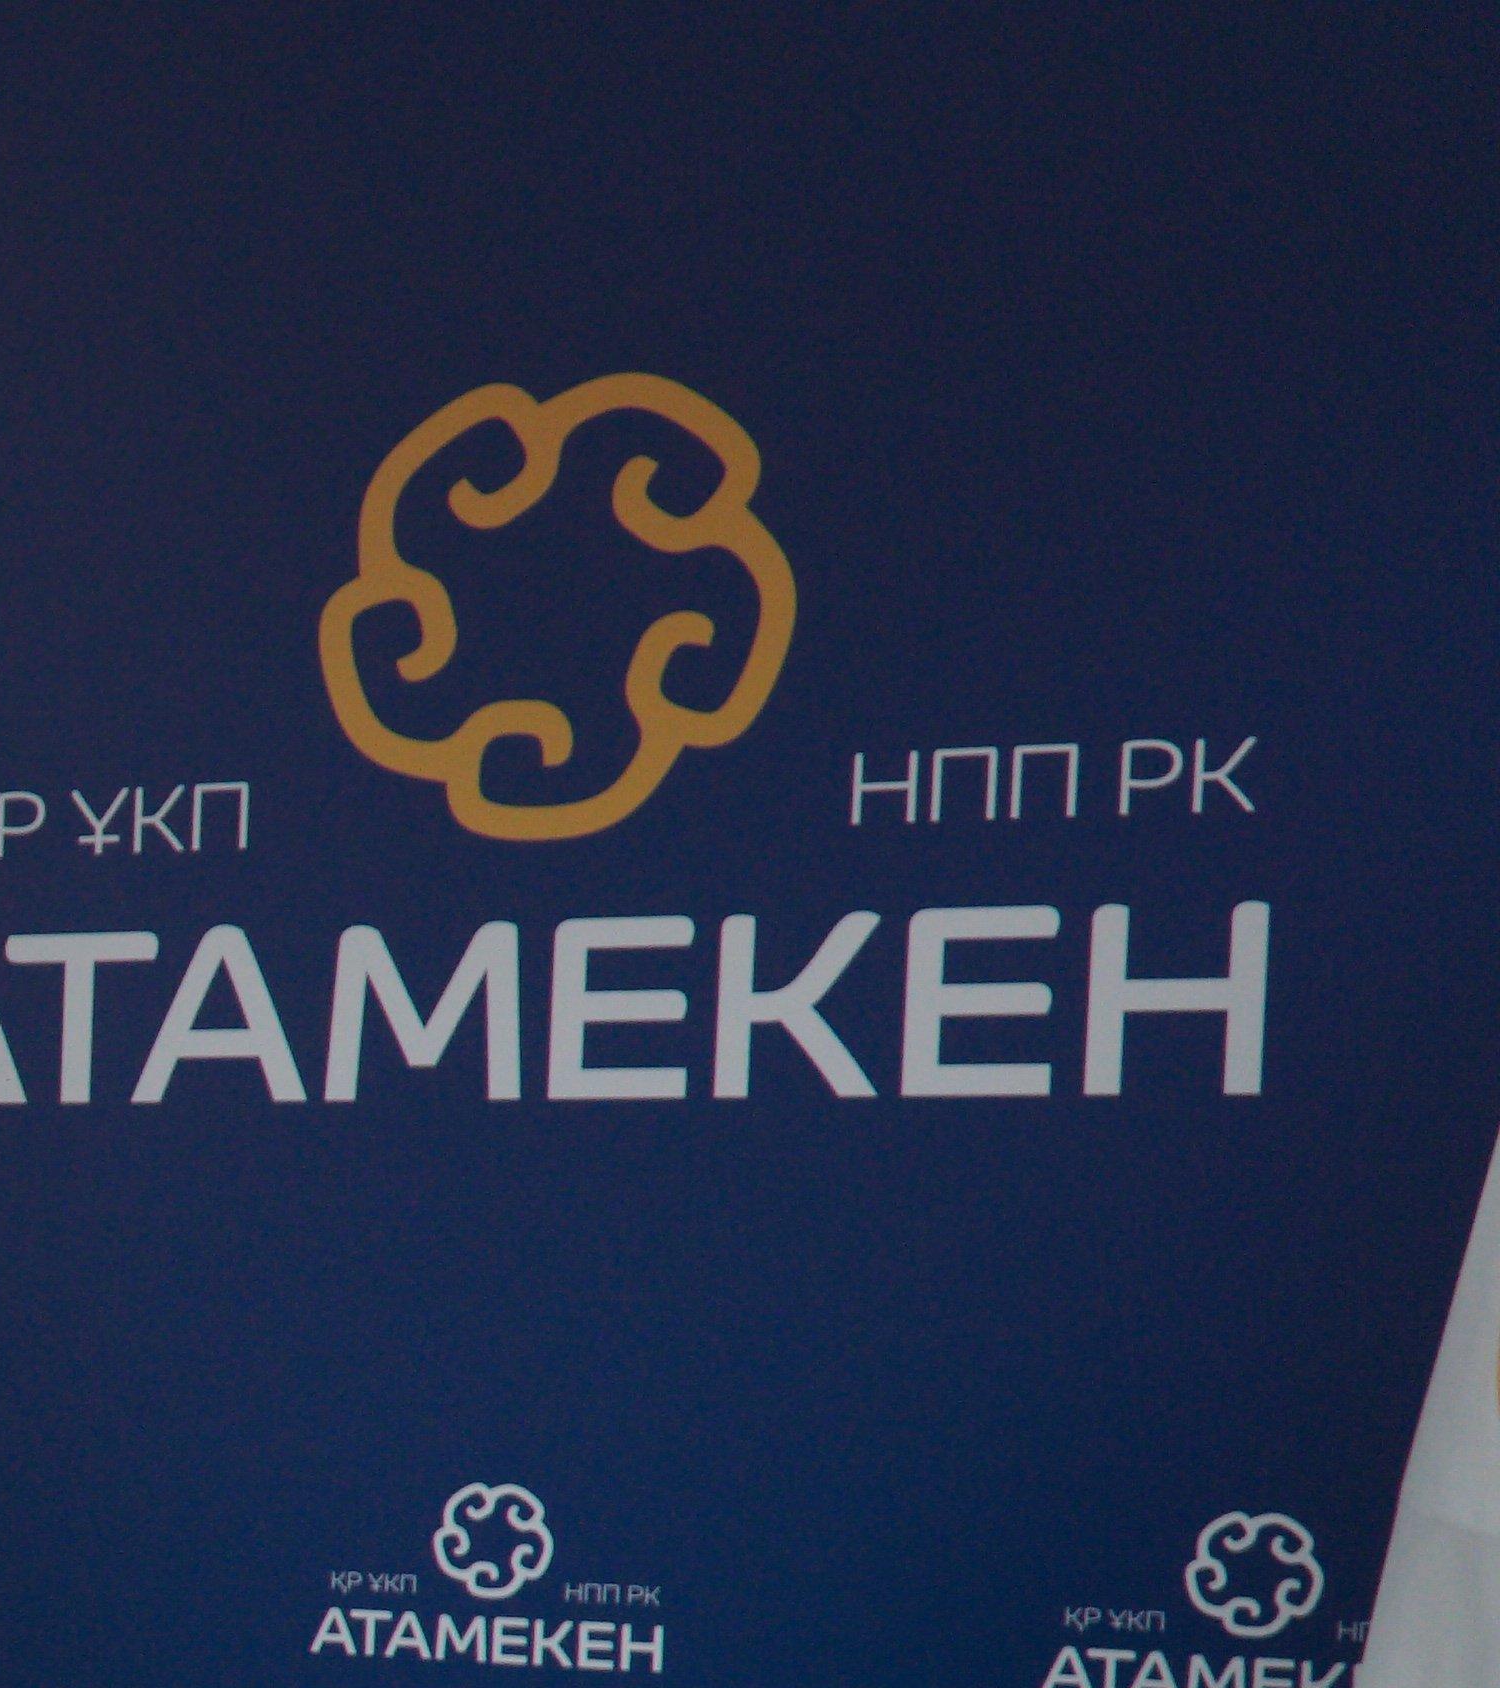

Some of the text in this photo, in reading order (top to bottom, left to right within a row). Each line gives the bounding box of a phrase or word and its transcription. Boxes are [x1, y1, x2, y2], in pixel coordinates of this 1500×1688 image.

[849, 736, 1257, 826] НПП РК
[563, 1582, 660, 1606] НПП РК
[309, 1606, 664, 1673] АТАМЕКЕН
